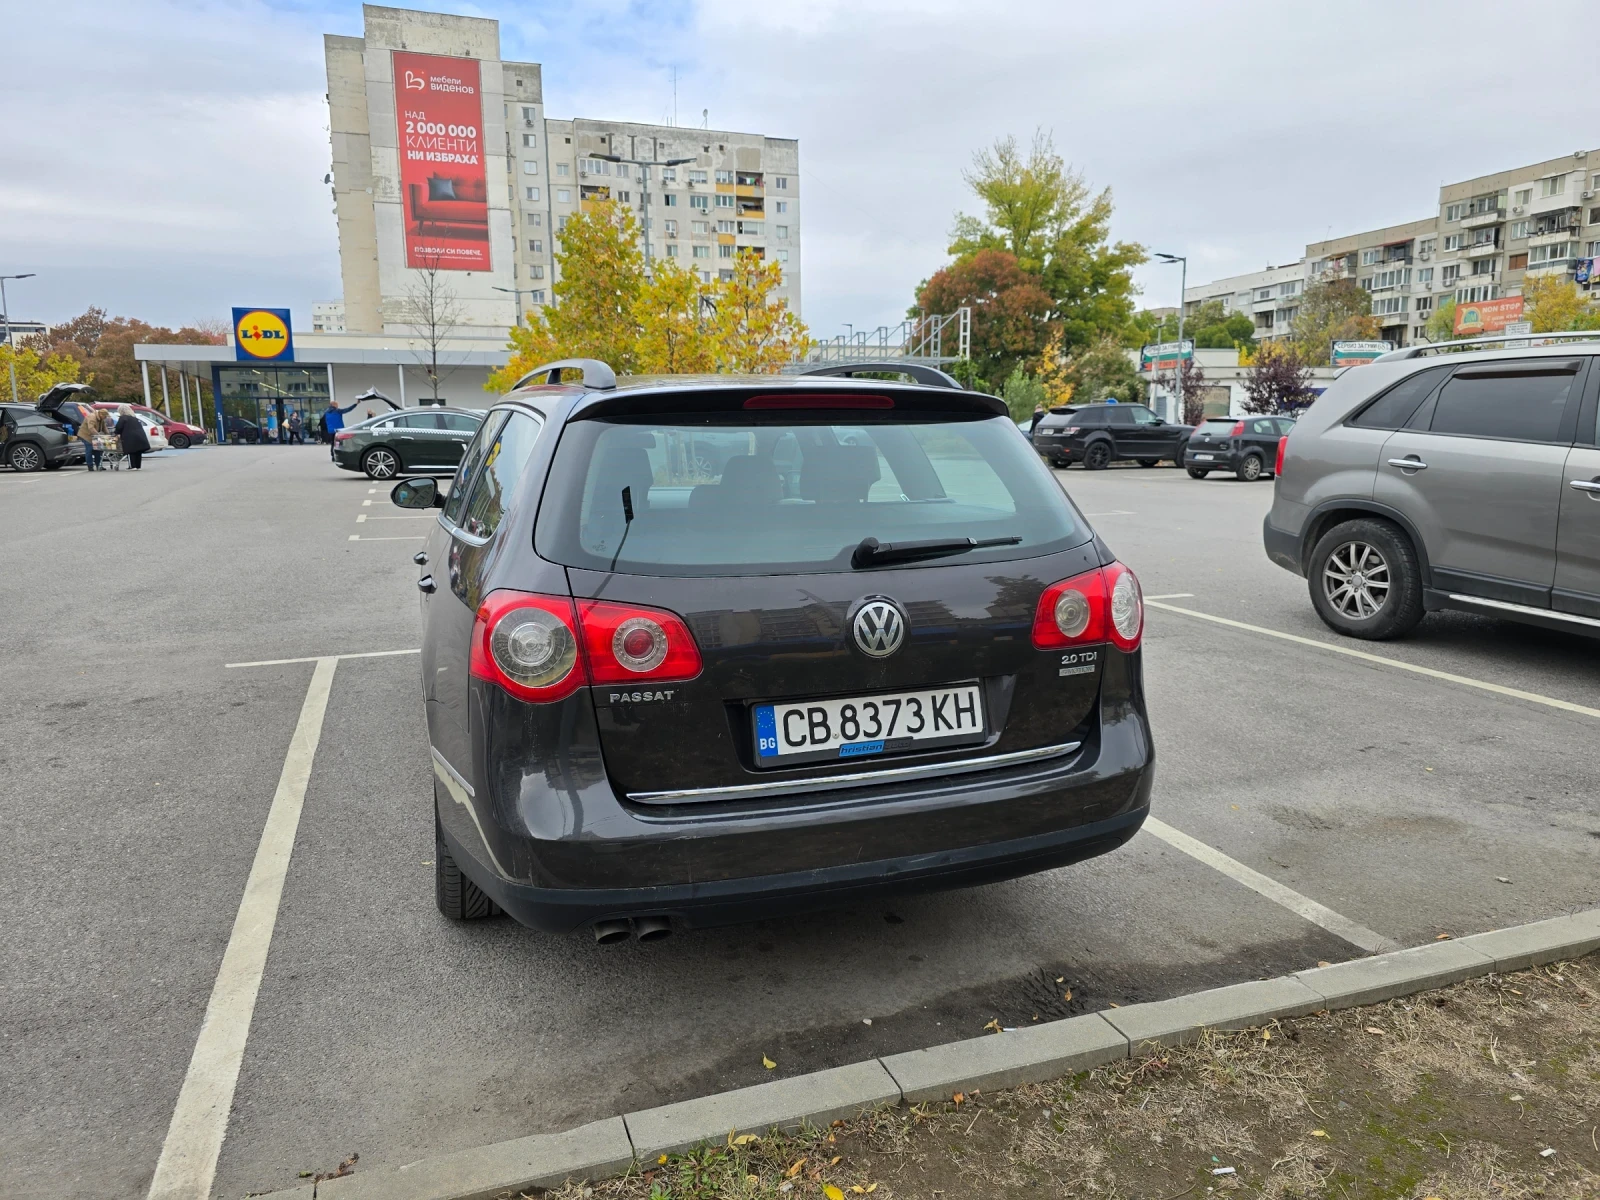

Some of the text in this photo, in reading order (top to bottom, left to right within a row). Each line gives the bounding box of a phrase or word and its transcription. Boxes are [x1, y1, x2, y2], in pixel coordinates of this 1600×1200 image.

[405, 110, 425, 120] НАД
[405, 121, 476, 138] 2 000 000
[406, 135, 477, 153] КЛИЕНТИ
[407, 150, 424, 160] НИ
[1482, 302, 1521, 314] NON STOP
[1079, 651, 1098, 662] TDI
[609, 690, 675, 704] PASSAT
[782, 691, 977, 747] CB 8373 KH
[759, 737, 776, 750] BG
[841, 744, 883, 754] hristian
